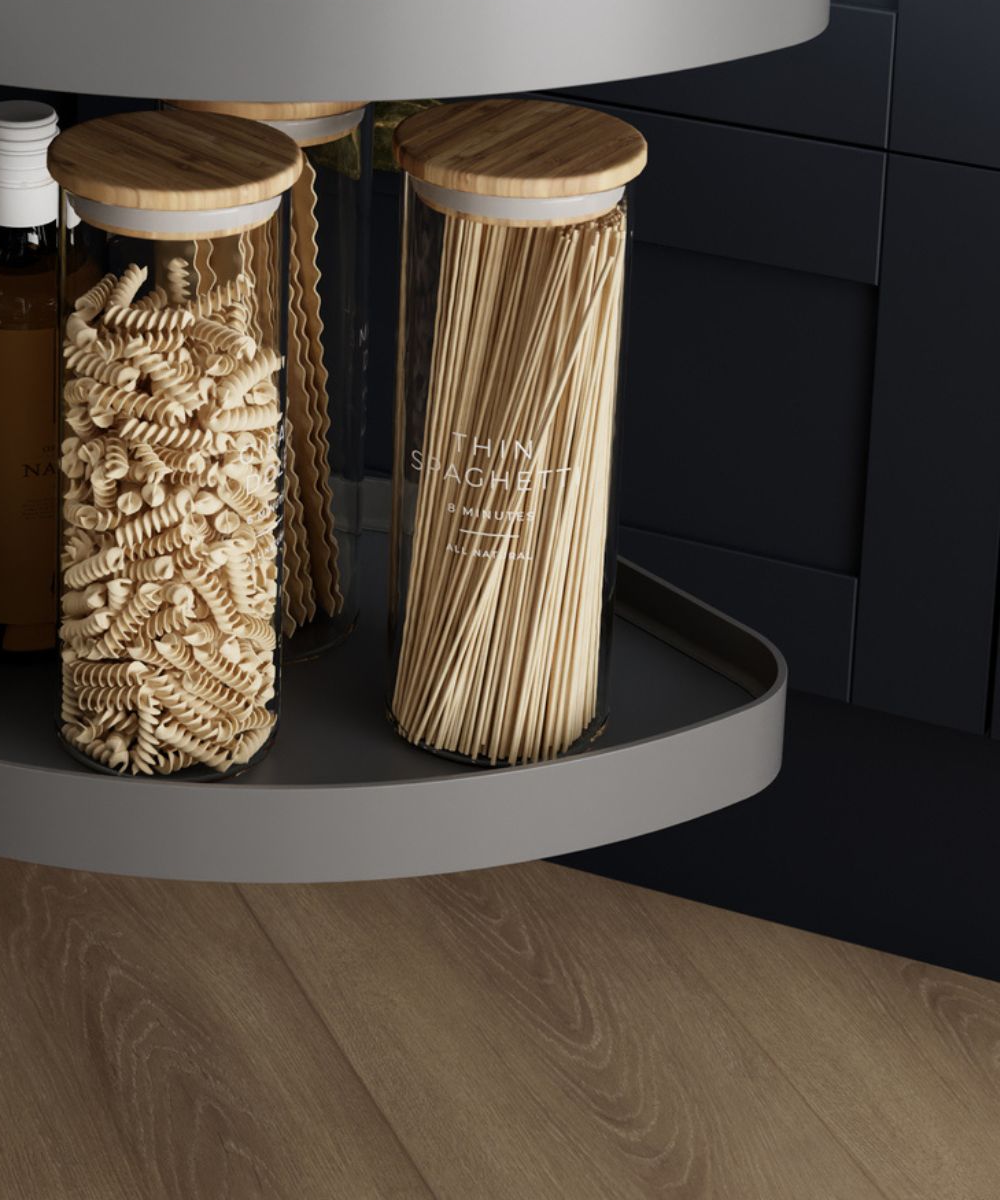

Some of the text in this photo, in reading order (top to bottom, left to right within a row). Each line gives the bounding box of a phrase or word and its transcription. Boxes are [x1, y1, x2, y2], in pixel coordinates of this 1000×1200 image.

[452, 431, 532, 460] THIN
[411, 450, 576, 491] SPAGHETT
[463, 507, 536, 522] MINUTES
[472, 549, 532, 561] NATRAL
